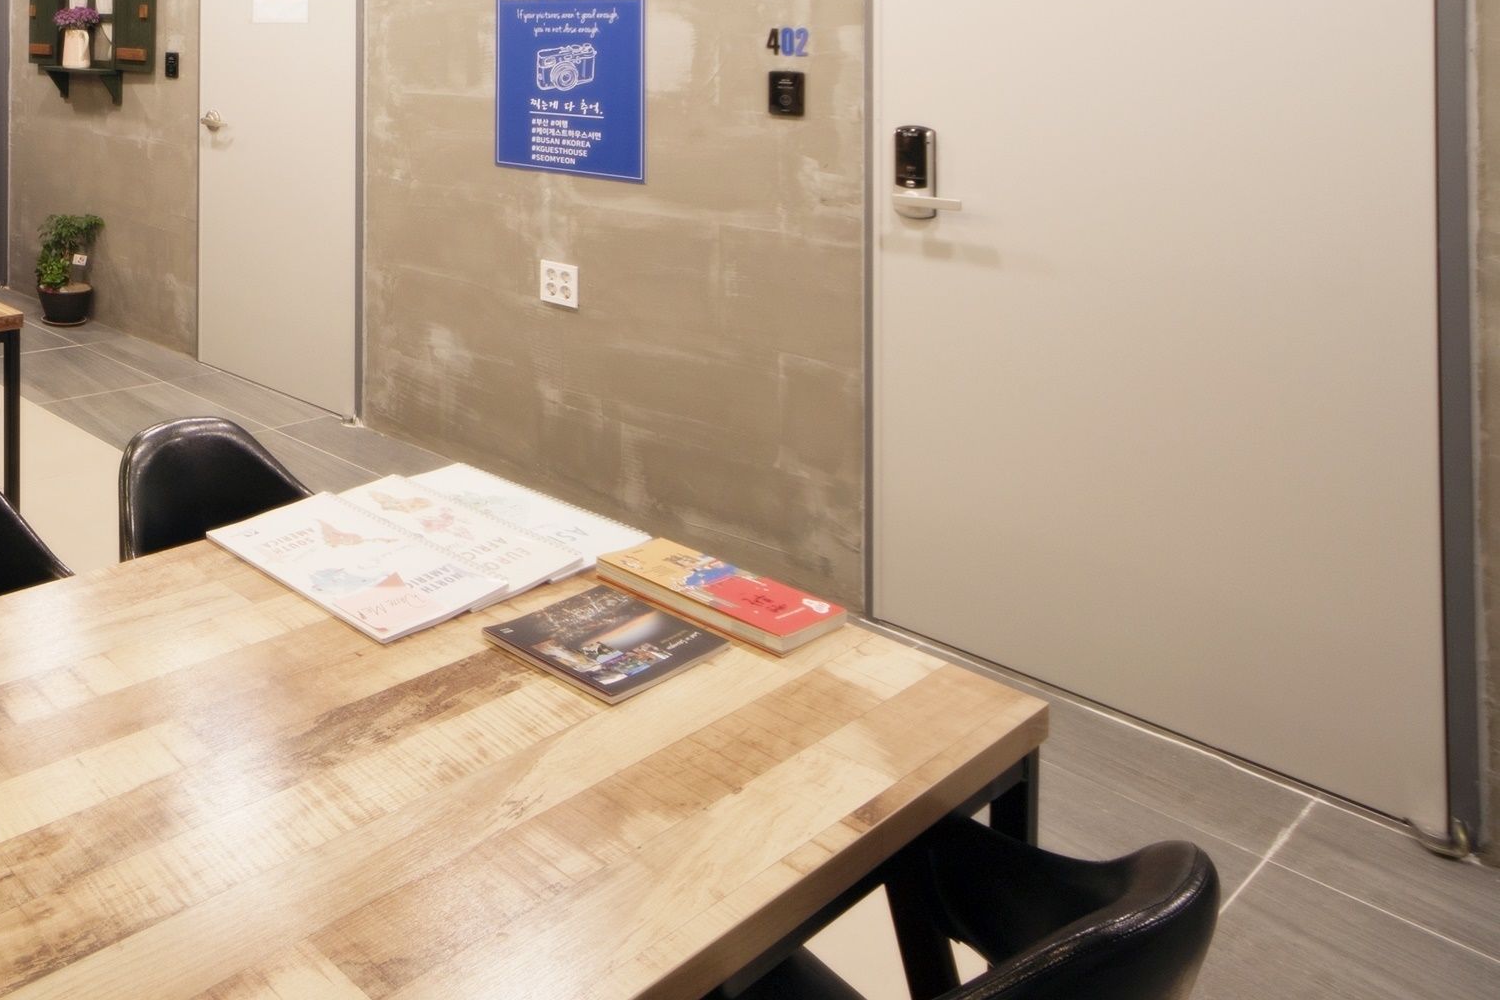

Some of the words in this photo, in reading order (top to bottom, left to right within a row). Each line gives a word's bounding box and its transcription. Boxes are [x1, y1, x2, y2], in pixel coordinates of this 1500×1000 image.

[766, 27, 809, 57] 402
[564, 101, 576, 112] 다
[531, 118, 549, 127] #부산
[550, 119, 568, 128] #여행
[531, 136, 560, 145] #BUSAN
[561, 139, 591, 148] #KOREA
[531, 145, 588, 157] #KGUESTHOUSE
[531, 154, 576, 165] #SEOMYEON
[262, 527, 315, 549] AMERICA
[275, 538, 316, 554] SOUTH
[461, 536, 508, 562] AFRIC
[485, 546, 532, 572] EURO
[405, 564, 452, 588] AMERIC
